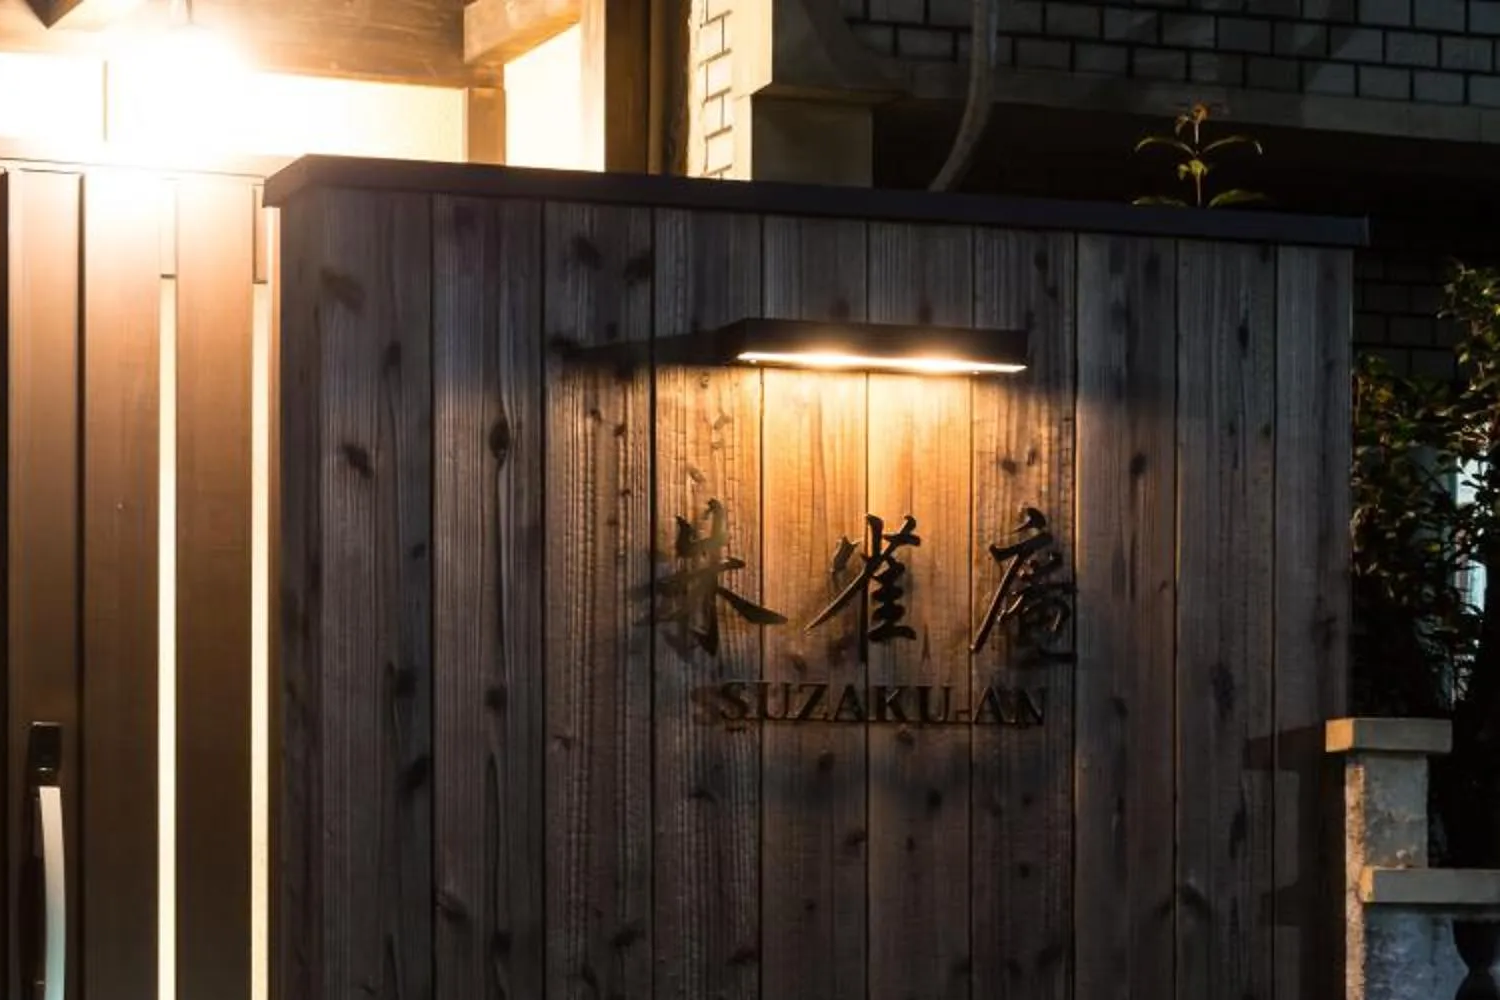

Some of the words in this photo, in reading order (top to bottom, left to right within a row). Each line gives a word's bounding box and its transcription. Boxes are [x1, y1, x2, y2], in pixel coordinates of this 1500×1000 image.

[636, 498, 1078, 662] 朱雀庵
[719, 680, 1046, 726] SUZAKU-AN
